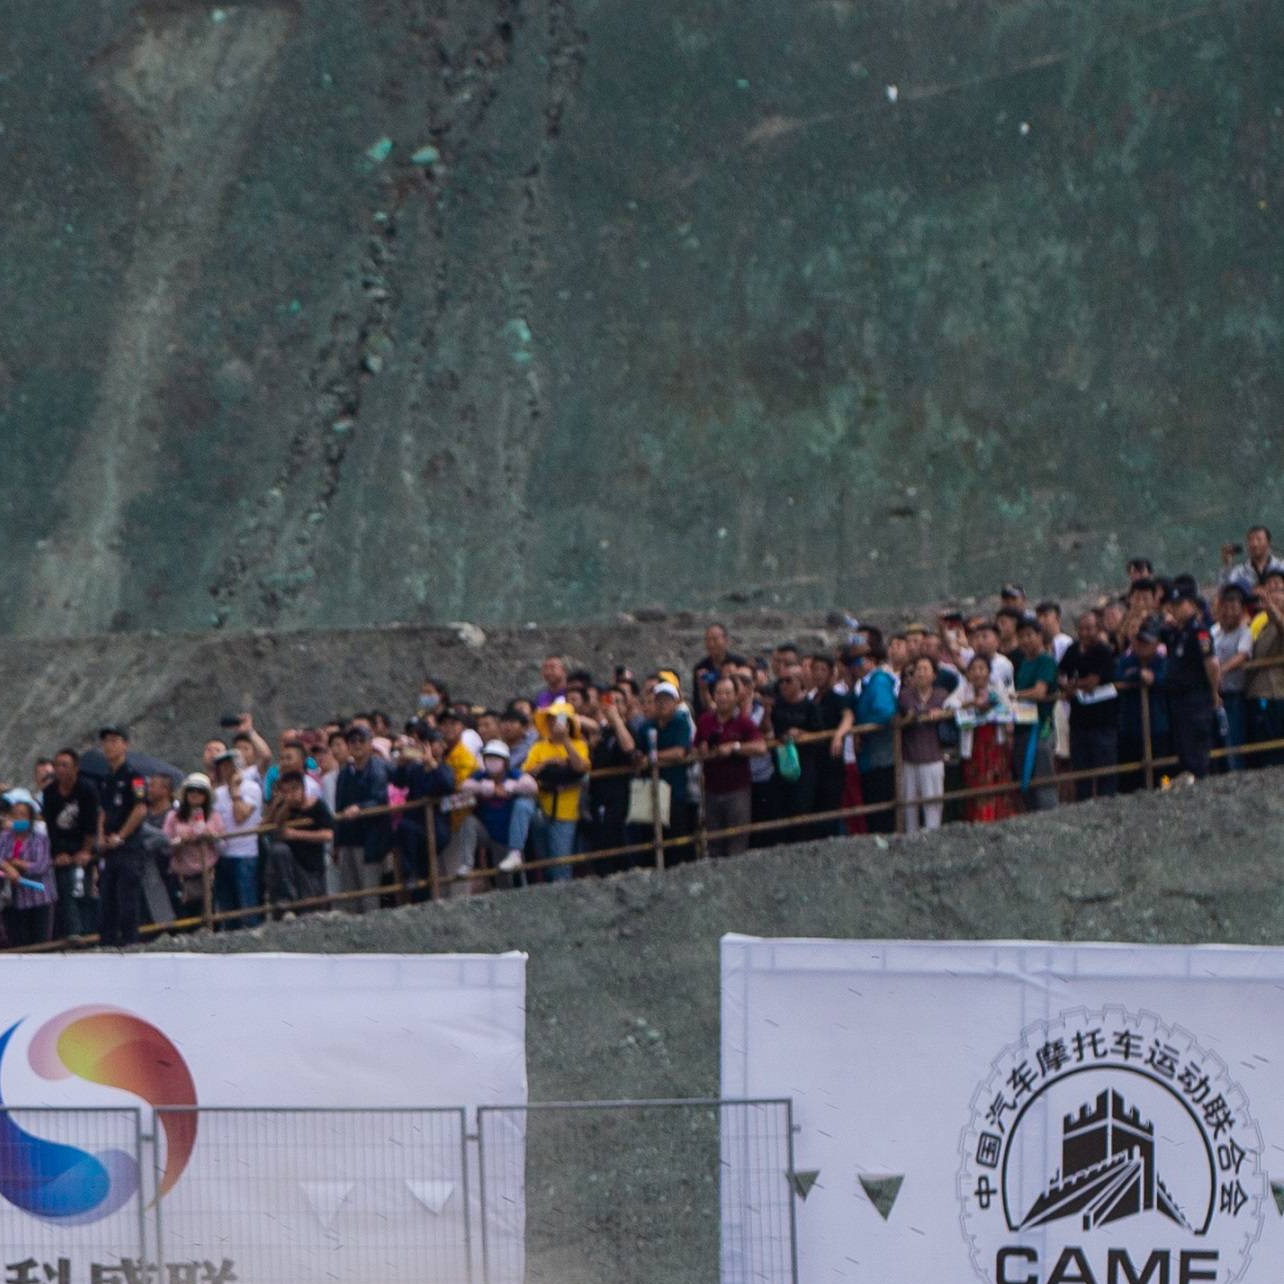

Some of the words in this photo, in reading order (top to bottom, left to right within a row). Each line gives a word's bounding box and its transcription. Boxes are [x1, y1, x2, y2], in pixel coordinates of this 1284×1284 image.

[974, 1027, 1249, 1218] 中国汽车摩托车运动联合会
